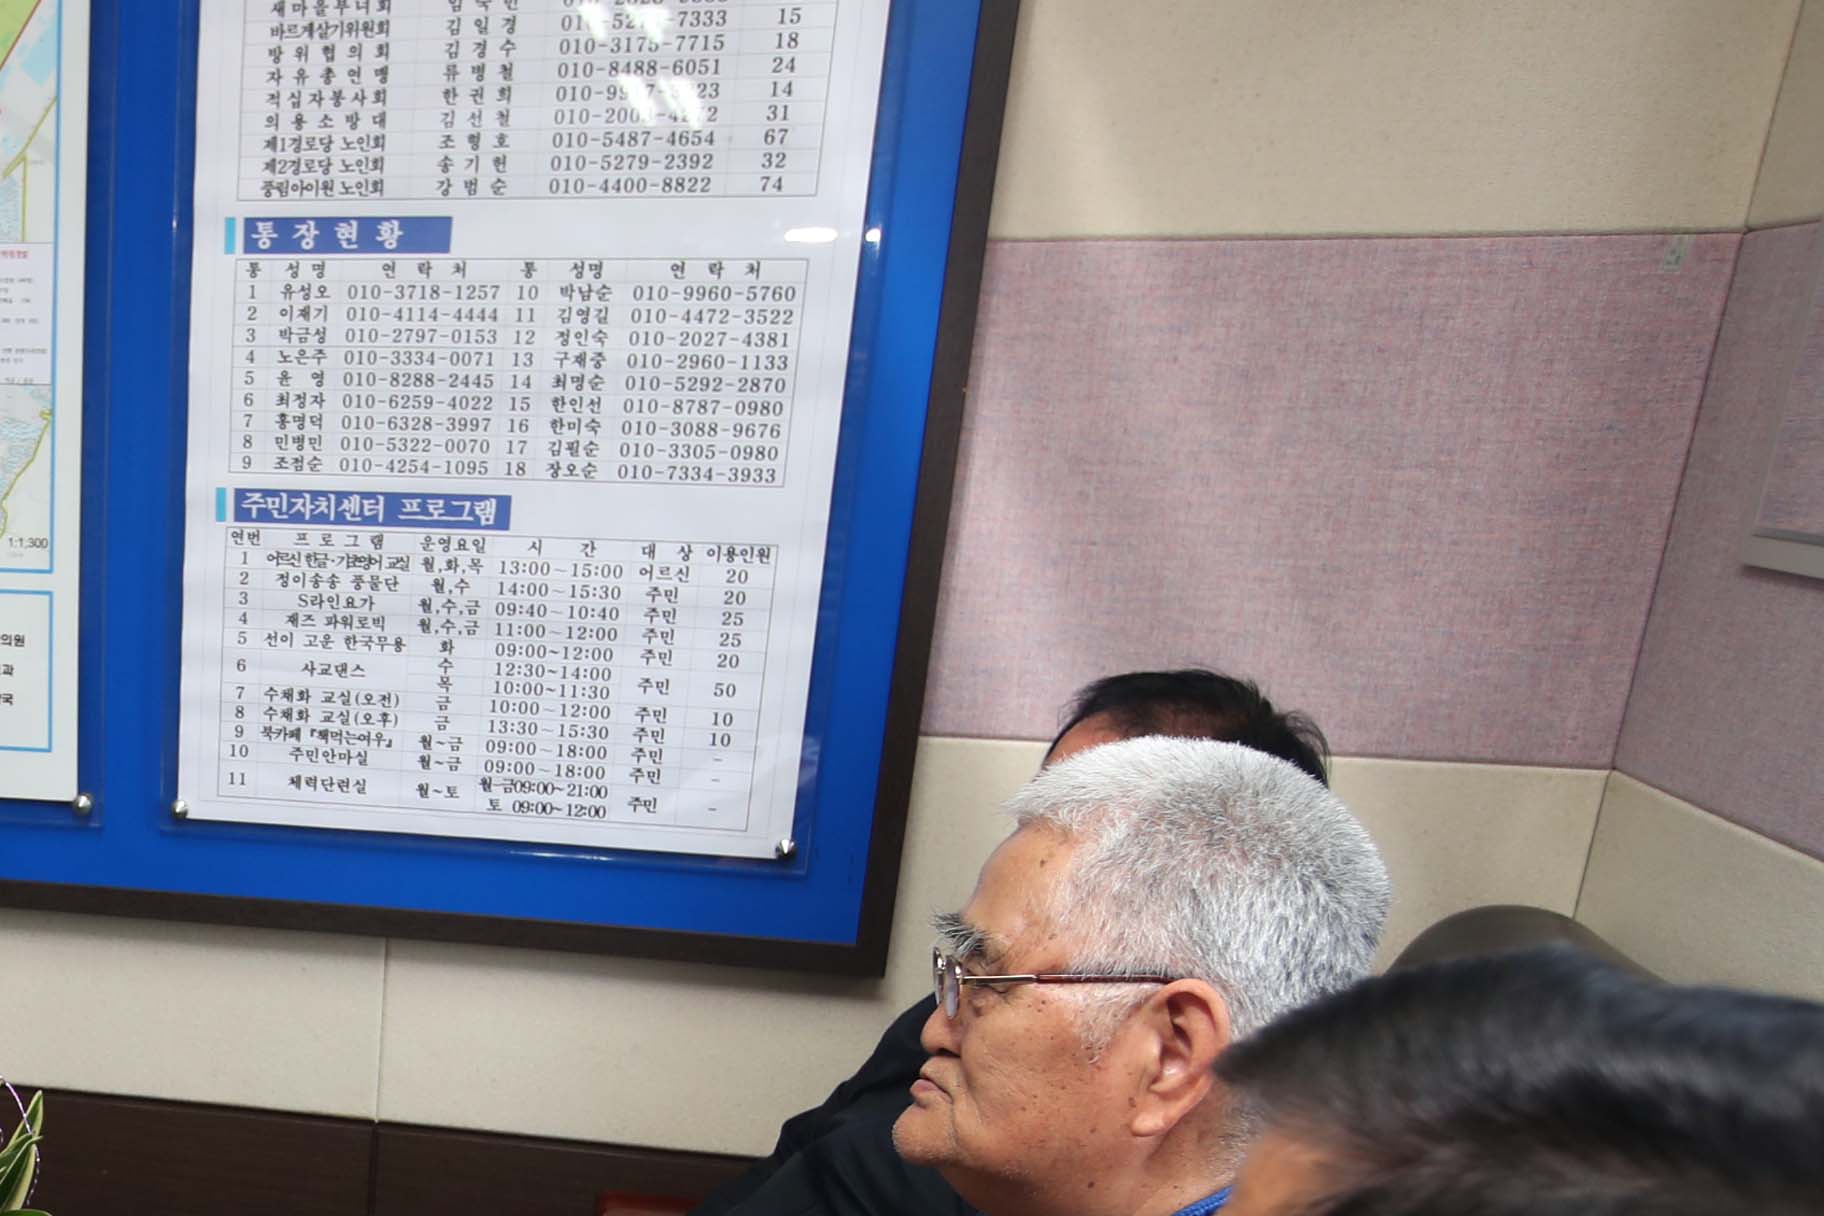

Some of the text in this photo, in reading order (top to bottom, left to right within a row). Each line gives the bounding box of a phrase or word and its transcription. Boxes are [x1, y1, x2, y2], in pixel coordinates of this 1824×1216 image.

[778, 8, 801, 25] 15
[559, 34, 725, 55] 010-3175-7715
[775, 32, 799, 49] 18
[557, 59, 721, 78] 010-8488-6051
[772, 57, 796, 73] 24
[770, 81, 793, 97] 14
[767, 105, 789, 121] 31
[263, 134, 334, 154] 제1경로당
[340, 133, 386, 152] 노인회
[552, 130, 715, 149] 010-5487-4654
[764, 128, 788, 145] 67
[262, 157, 333, 176] 제2경로당
[338, 156, 385, 174] 노인회
[550, 153, 713, 171] 010-5279-2392
[761, 152, 786, 168] 32
[338, 178, 385, 197] 노인회
[549, 176, 711, 194] 010-4400-8822
[760, 175, 784, 192] 74
[348, 284, 500, 300] 010-3718-1257
[633, 285, 796, 302] 010-9960-5760
[347, 306, 498, 322] 010-4114-4444
[631, 308, 794, 325] 010-4472-3522
[345, 329, 497, 345] 010-2797-0153
[629, 331, 790, 348] 010-2027-4381
[344, 350, 494, 367] 010-3334-0071
[627, 353, 789, 371] 010-2960-1133
[343, 371, 495, 388] 010-8288-2445
[625, 376, 786, 393] 010-5292-2870
[342, 393, 493, 411] 010-6259-4022
[623, 398, 783, 417] 010-8787-0980
[342, 415, 491, 432] 010-6328-3997
[622, 420, 781, 439] 010-3088-9676
[340, 436, 490, 453] 010-5322-0070
[620, 442, 779, 461] 010-3305-0980
[339, 457, 489, 475] 010-4254-1095
[618, 464, 776, 484] 010-7334-3933
[241, 493, 497, 525] 주민자치센터 프로그램
[706, 546, 771, 565] 이용인원
[639, 565, 690, 583] 어르신
[726, 568, 748, 585] 20
[645, 586, 678, 603] 주민
[724, 590, 746, 606] 20
[297, 592, 376, 611] S라인요가
[721, 611, 744, 627] 25
[719, 632, 741, 648] 25
[303, 633, 335, 649] 고운
[344, 635, 406, 652] 한국무용
[716, 653, 740, 669] 20
[301, 661, 736, 698] 사교댄스 50
[262, 705, 310, 724] 수채화
[263, 686, 311, 704] 수채화
[711, 711, 733, 727] 10
[288, 747, 368, 766] 주민안마실
